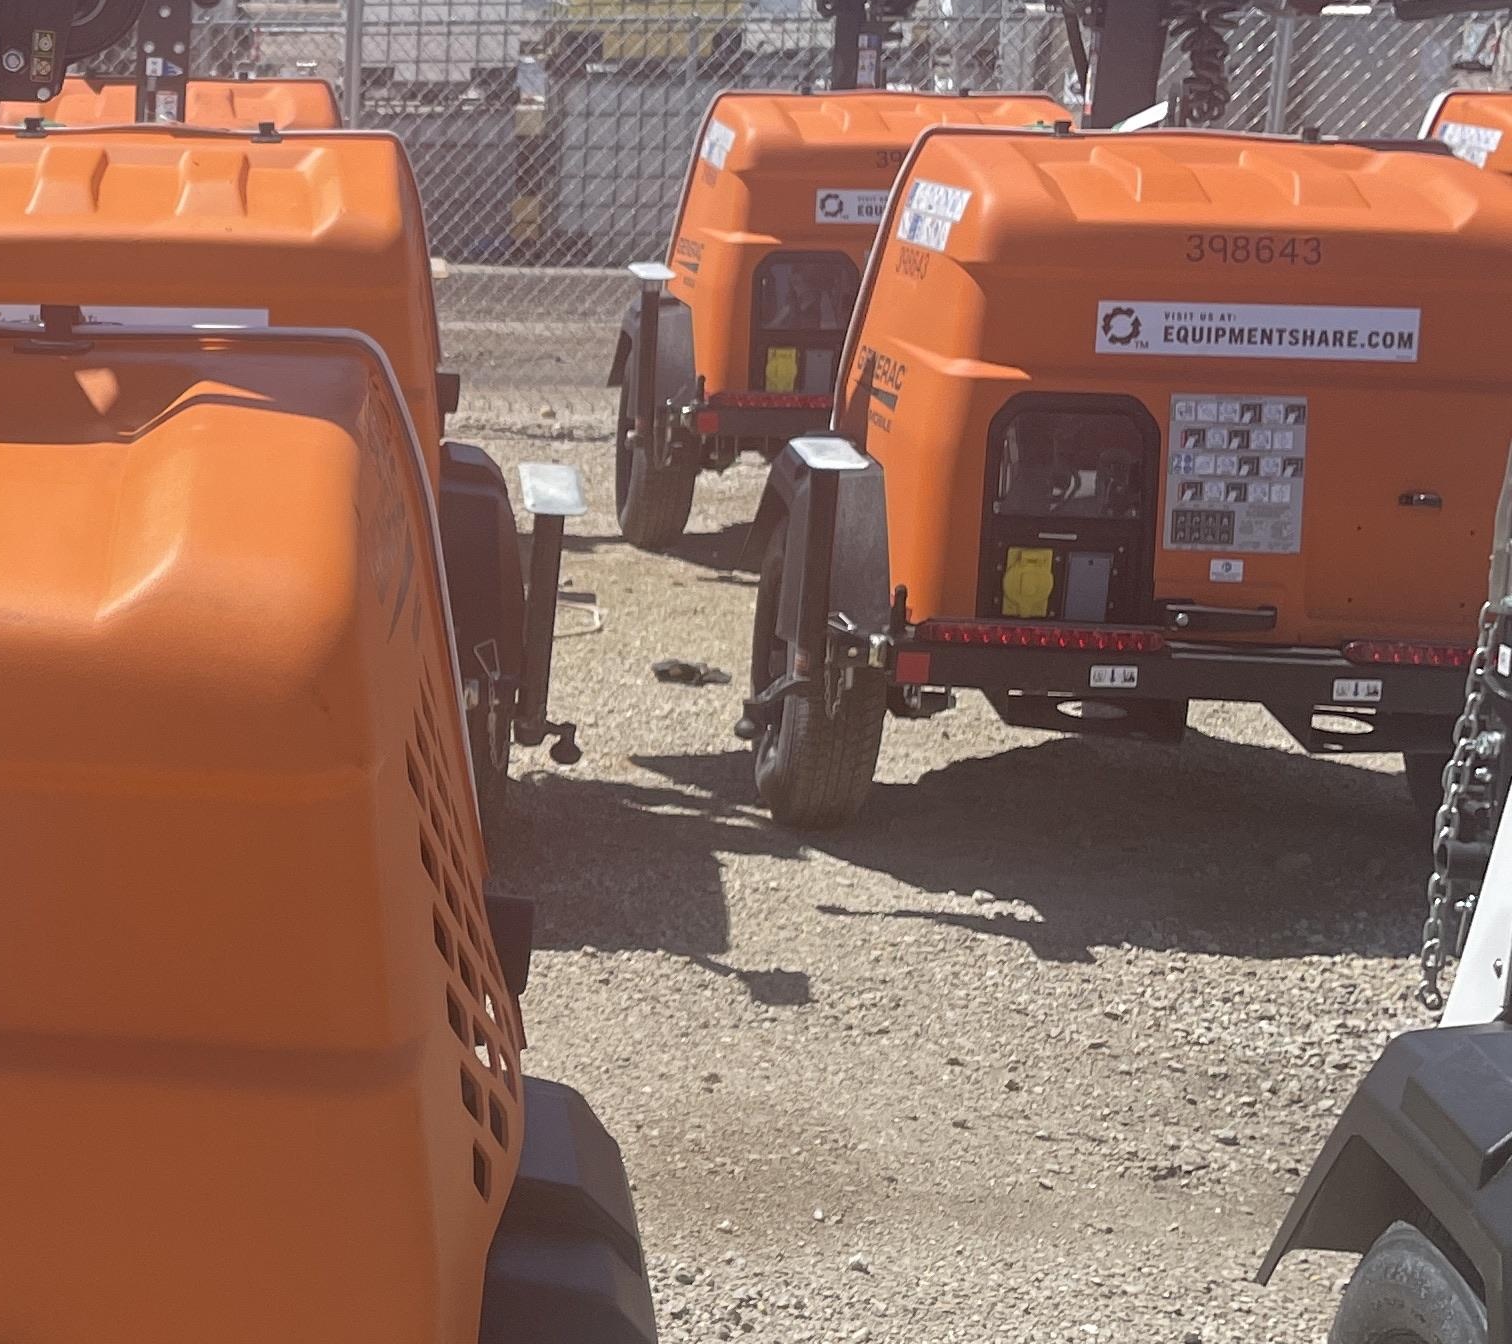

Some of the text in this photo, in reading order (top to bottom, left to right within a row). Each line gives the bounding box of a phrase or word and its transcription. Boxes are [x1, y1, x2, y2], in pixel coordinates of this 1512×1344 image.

[1186, 233, 1322, 265] 398643
[1164, 311, 1194, 322] VISIT
[1199, 312, 1214, 322] US
[1163, 325, 1414, 350] EQUIPMENTSHARE.COM
